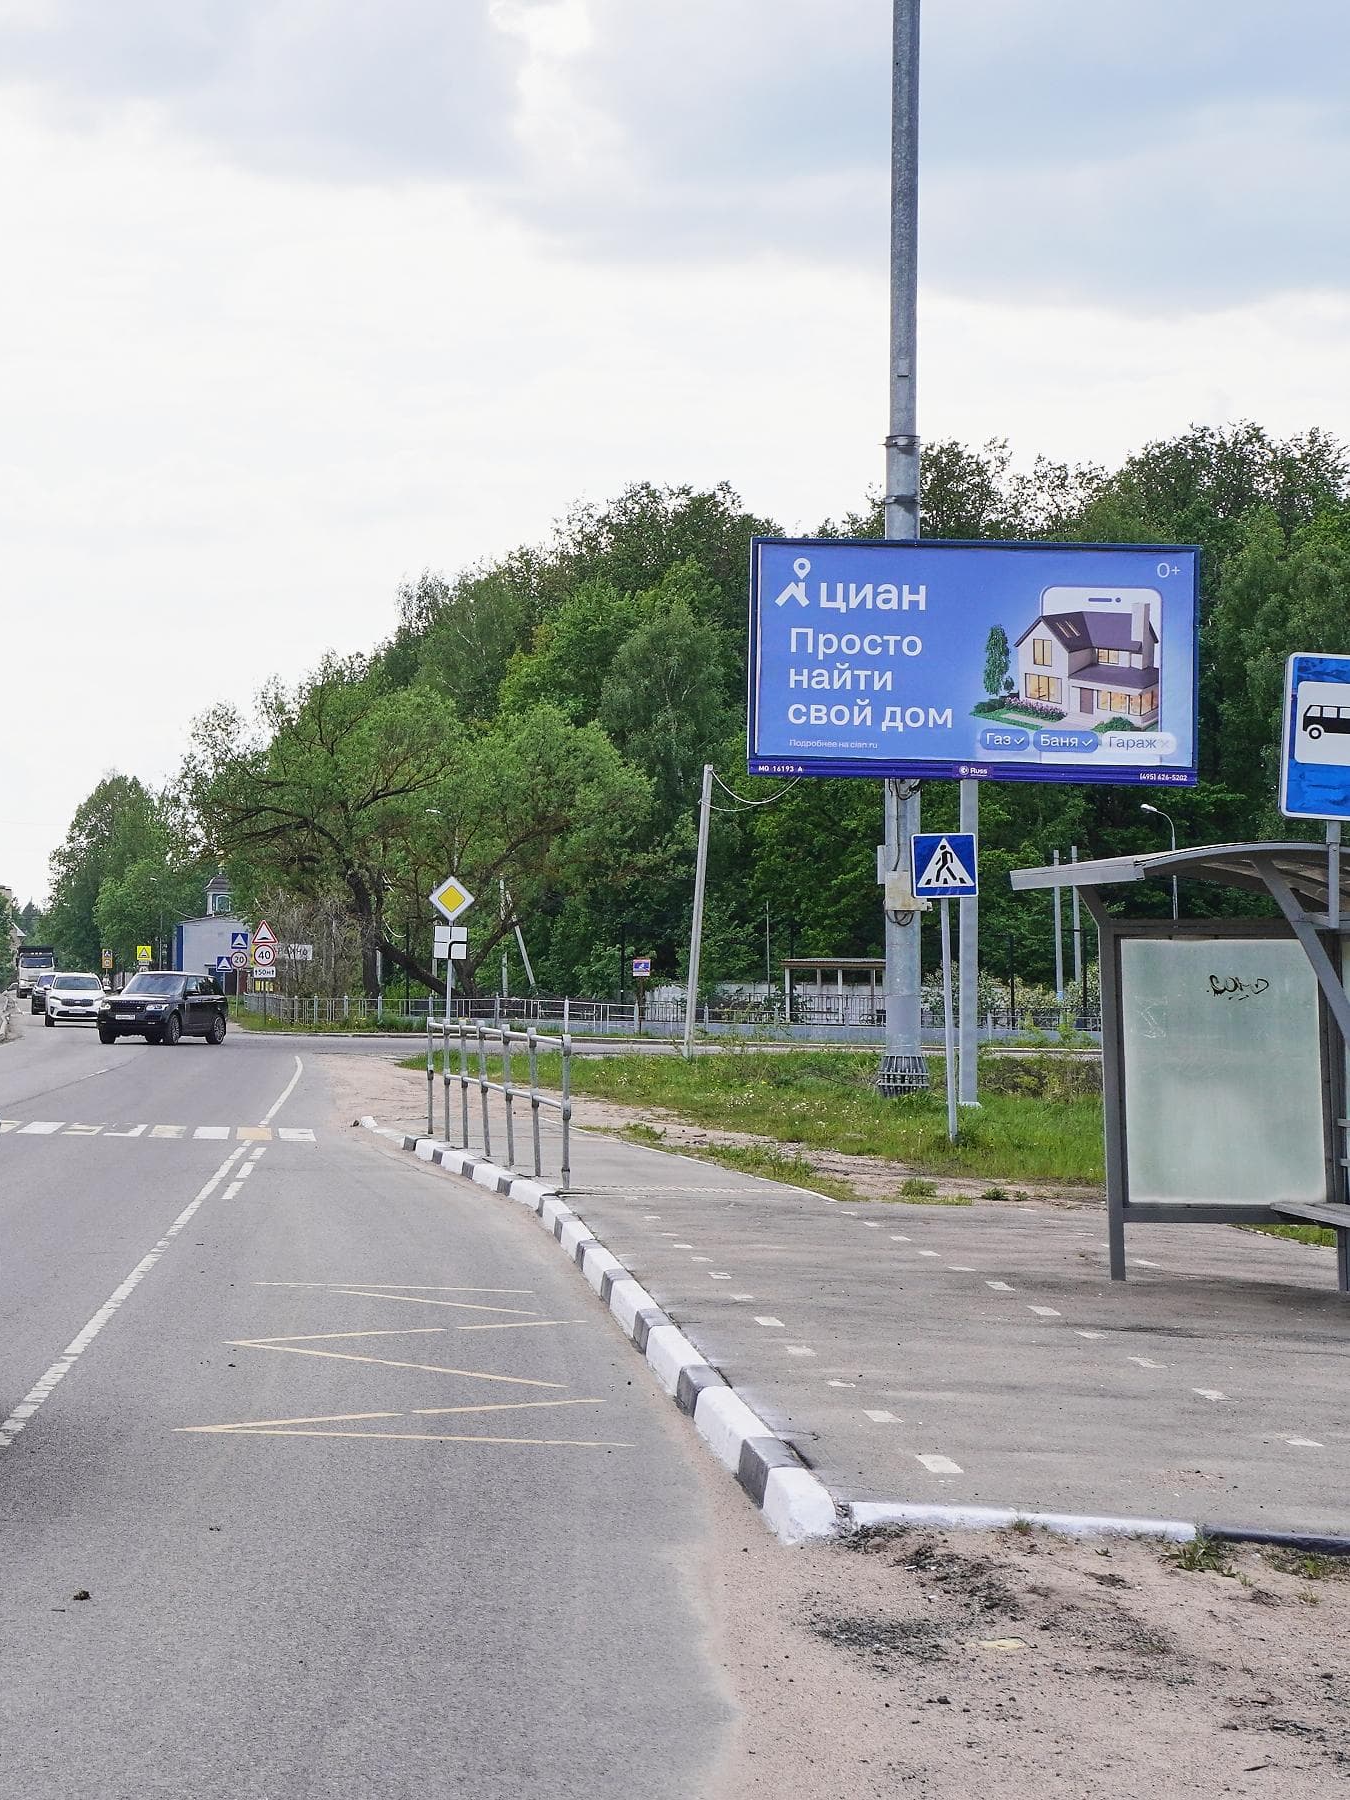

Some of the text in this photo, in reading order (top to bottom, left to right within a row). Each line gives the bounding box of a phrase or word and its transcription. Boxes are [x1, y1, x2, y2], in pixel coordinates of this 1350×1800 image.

[1156, 562, 1181, 578] 0+
[819, 582, 927, 613] циан
[790, 627, 923, 660] Просто
[789, 662, 892, 691] найти
[787, 698, 953, 732] свой дом
[789, 739, 837, 749] Подробнее
[986, 733, 1011, 745] Газ
[1040, 734, 1079, 747] Баня
[1109, 736, 1157, 749] Гараж
[772, 765, 795, 773] 16193
[970, 767, 988, 775] Russ
[1139, 773, 1188, 782] (495) 626-5202
[234, 956, 244, 964] 20
[257, 950, 271, 960] 40
